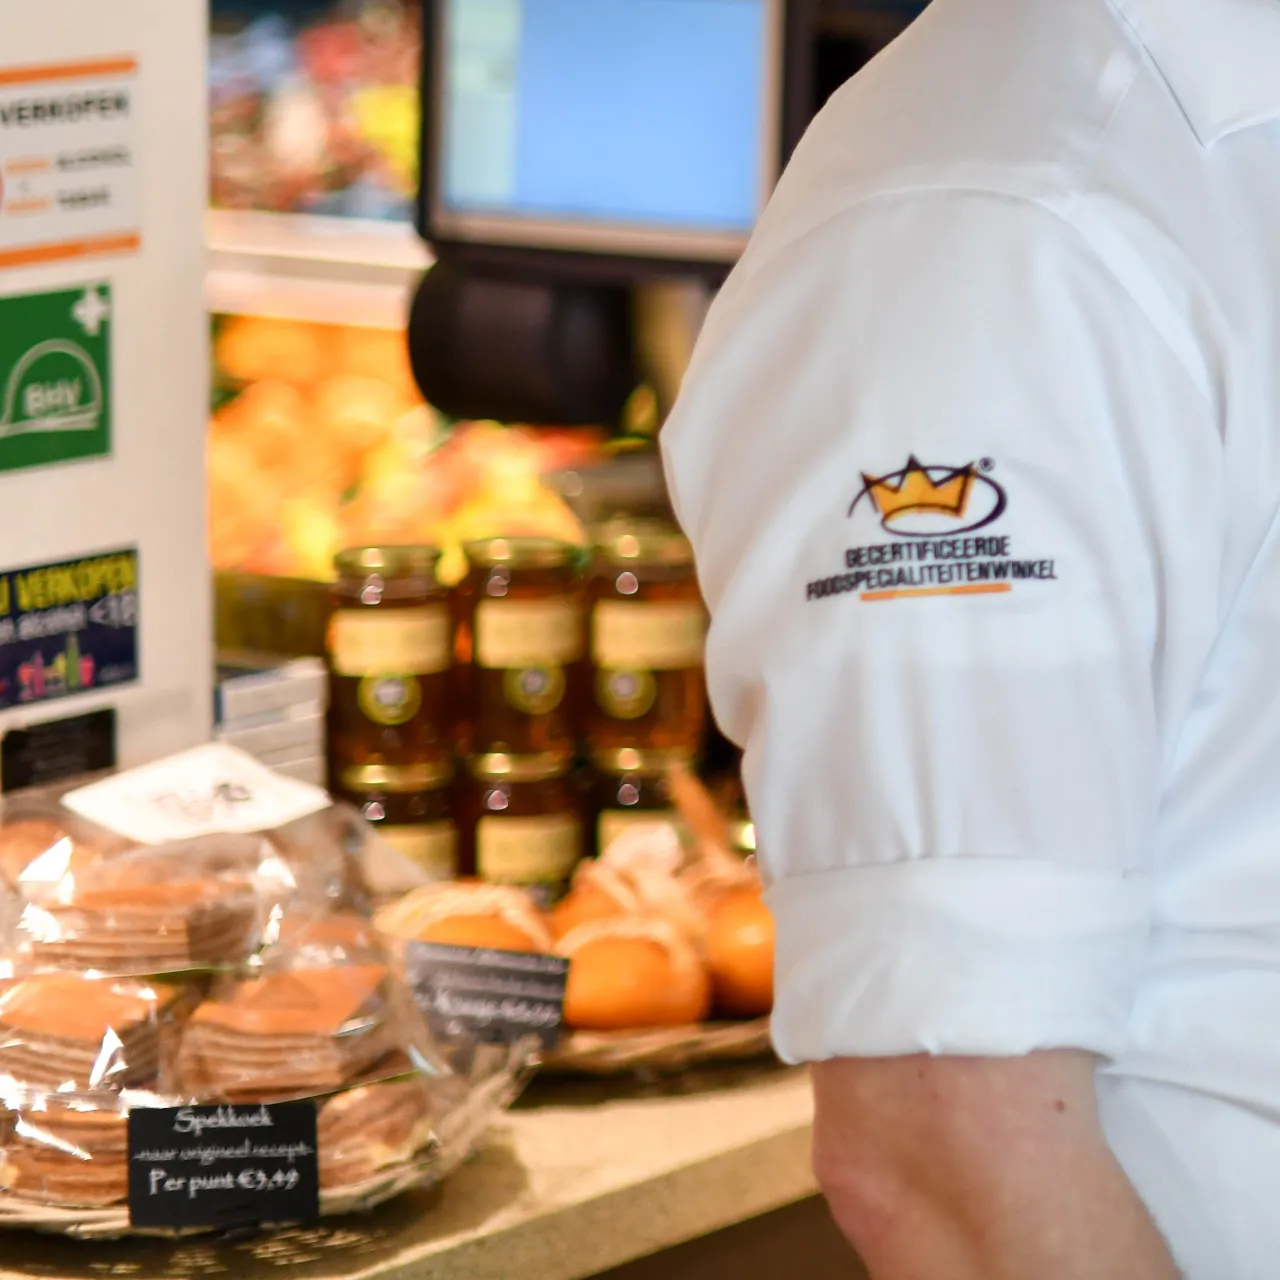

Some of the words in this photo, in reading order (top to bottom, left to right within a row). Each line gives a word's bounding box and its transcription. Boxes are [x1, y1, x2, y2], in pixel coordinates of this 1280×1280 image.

[23, 376, 80, 418] BHV
[845, 535, 1011, 569] GECERTIFICEERDE
[149, 1168, 187, 1196] Per
